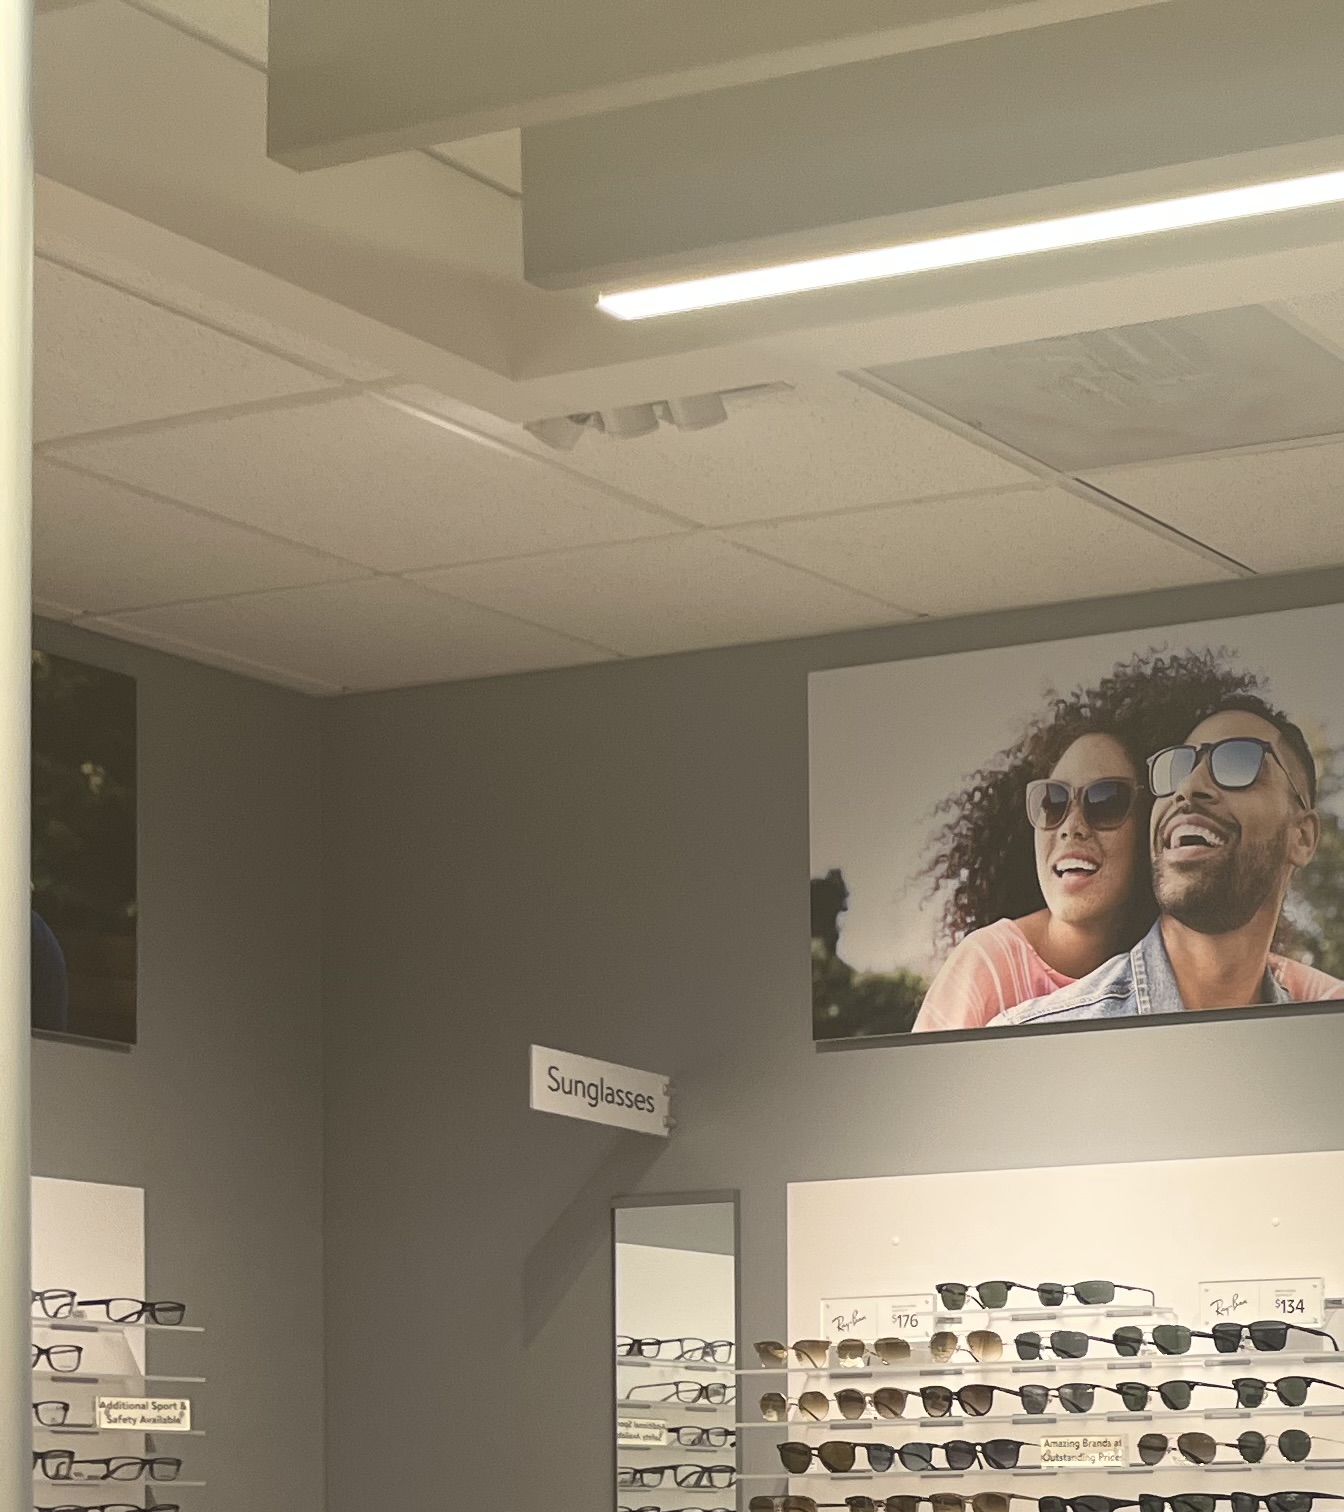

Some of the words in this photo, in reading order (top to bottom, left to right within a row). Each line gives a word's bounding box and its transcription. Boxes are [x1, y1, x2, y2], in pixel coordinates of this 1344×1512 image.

[548, 1066, 655, 1113] Sunglasses
[1275, 1298, 1304, 1313] $134
[892, 1314, 918, 1328] $176
[100, 1401, 148, 1410] Additional
[152, 1402, 178, 1412] Sport
[180, 1402, 186, 1410] &
[107, 1414, 136, 1425] Safety
[140, 1416, 181, 1424] Available
[1044, 1439, 1080, 1450] Amazing
[1082, 1438, 1111, 1447] Brands
[1042, 1453, 1095, 1464] Outstanding
